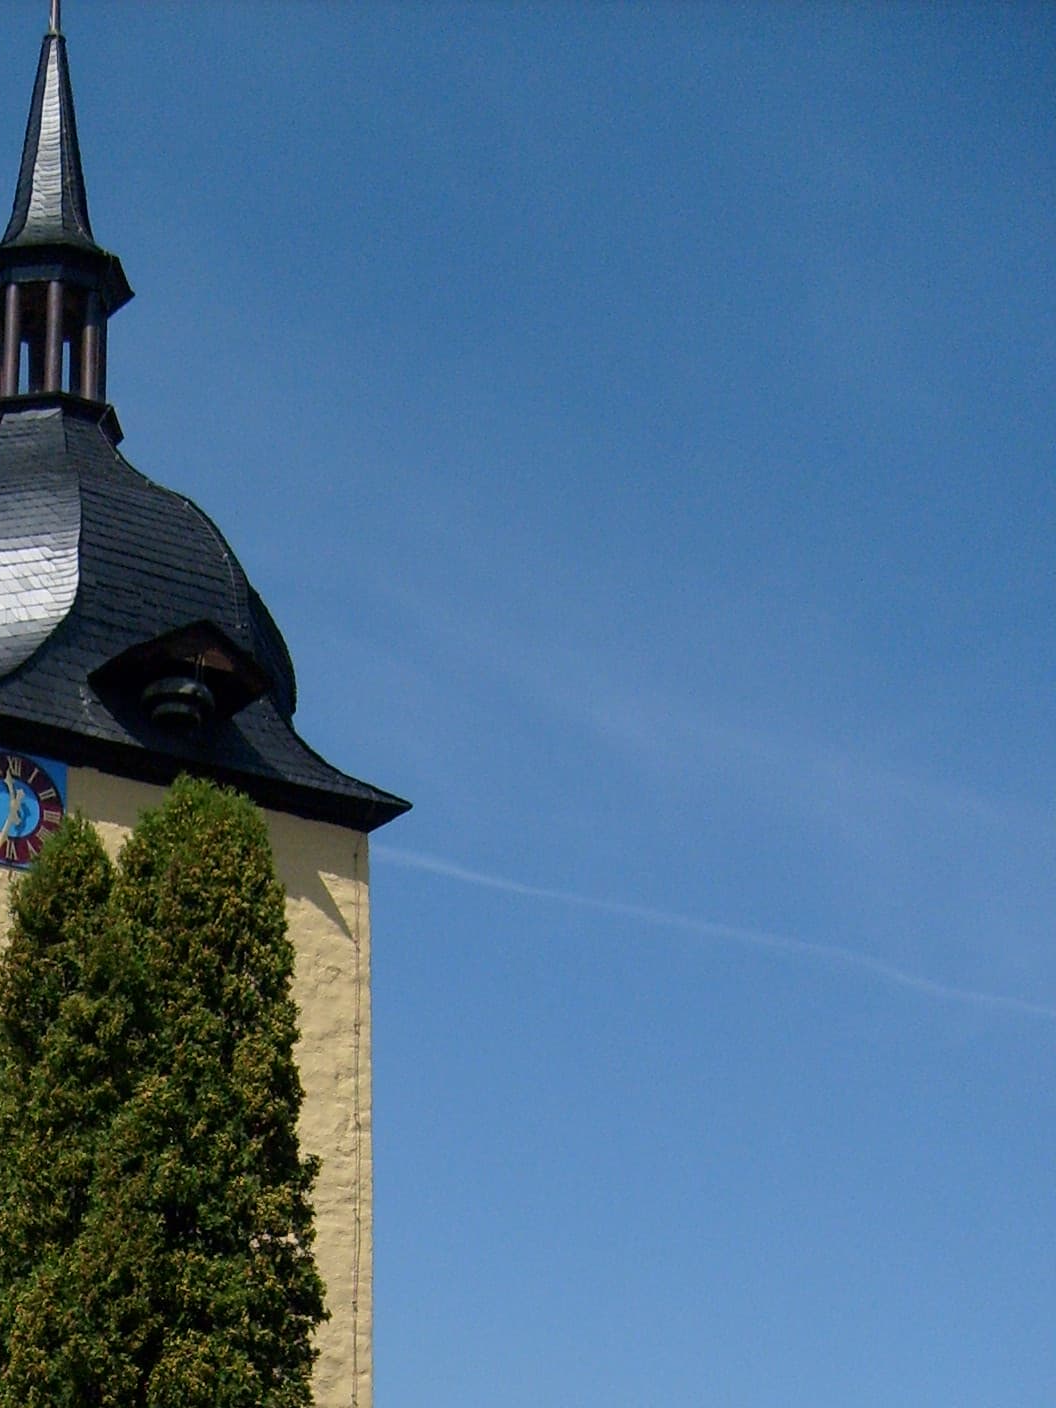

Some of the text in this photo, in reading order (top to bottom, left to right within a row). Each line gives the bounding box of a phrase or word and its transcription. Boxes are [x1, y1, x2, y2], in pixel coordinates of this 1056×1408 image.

[27, 767, 40, 784] I
[39, 787, 57, 801] II
[5, 839, 18, 860] VI
